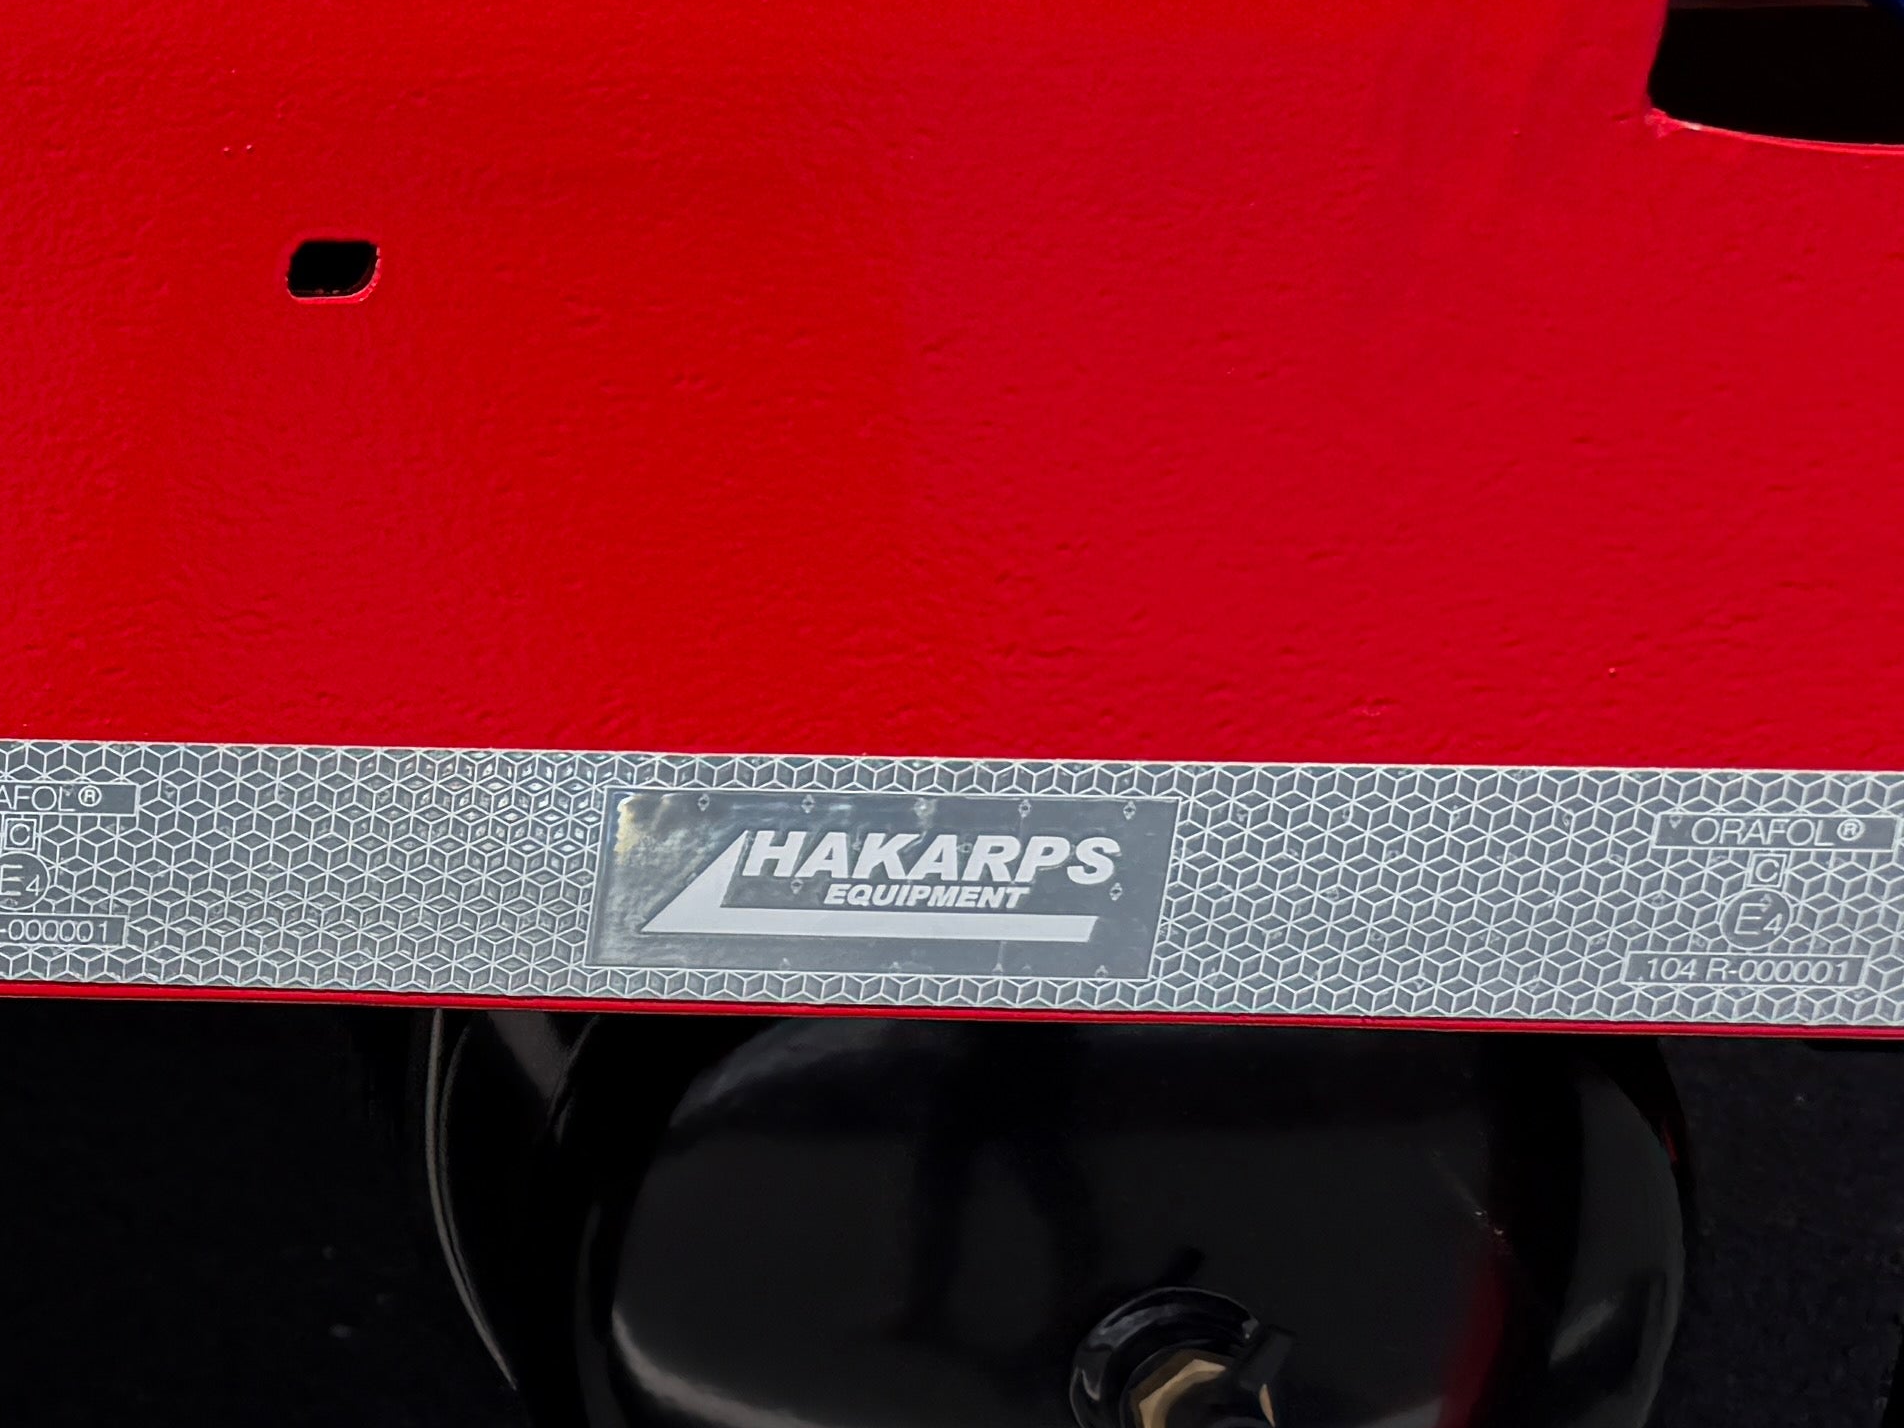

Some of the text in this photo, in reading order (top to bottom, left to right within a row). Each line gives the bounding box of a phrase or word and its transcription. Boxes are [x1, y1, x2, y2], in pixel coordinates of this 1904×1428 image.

[742, 829, 1122, 885] HAKARPS
[823, 882, 1031, 909] EQUIPMENT
[1646, 957, 1849, 983] 104 R-000001
